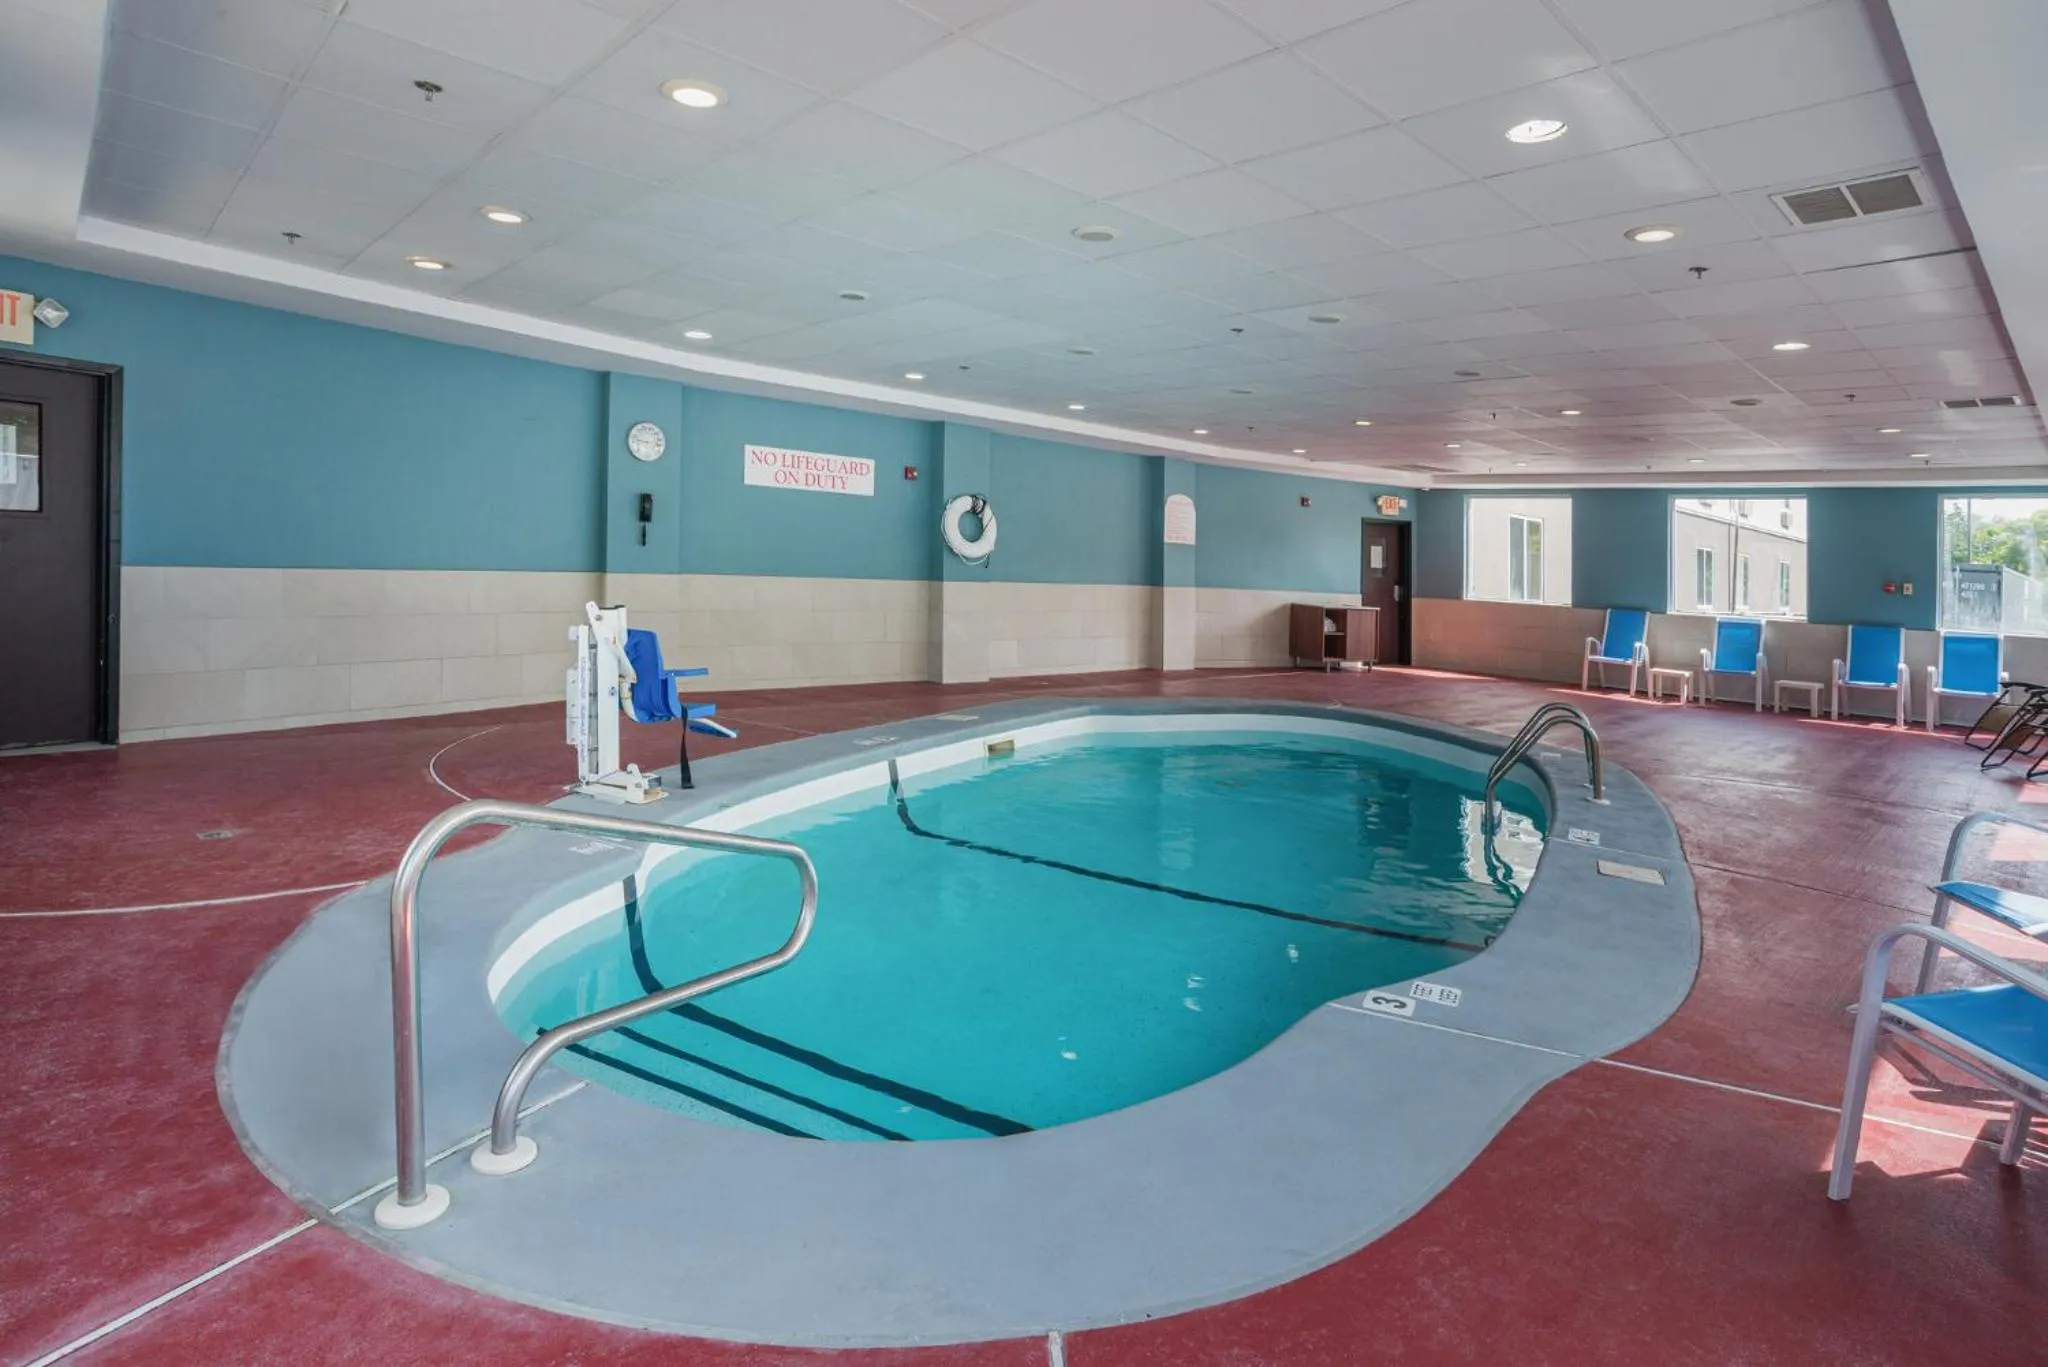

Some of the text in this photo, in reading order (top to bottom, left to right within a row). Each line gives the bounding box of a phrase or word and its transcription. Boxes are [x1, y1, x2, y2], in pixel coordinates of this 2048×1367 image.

[0, 292, 21, 327] IT
[751, 449, 870, 476] NO LIFEGUARD
[774, 469, 849, 490] ON DUTY
[1371, 996, 1409, 1010] 3
